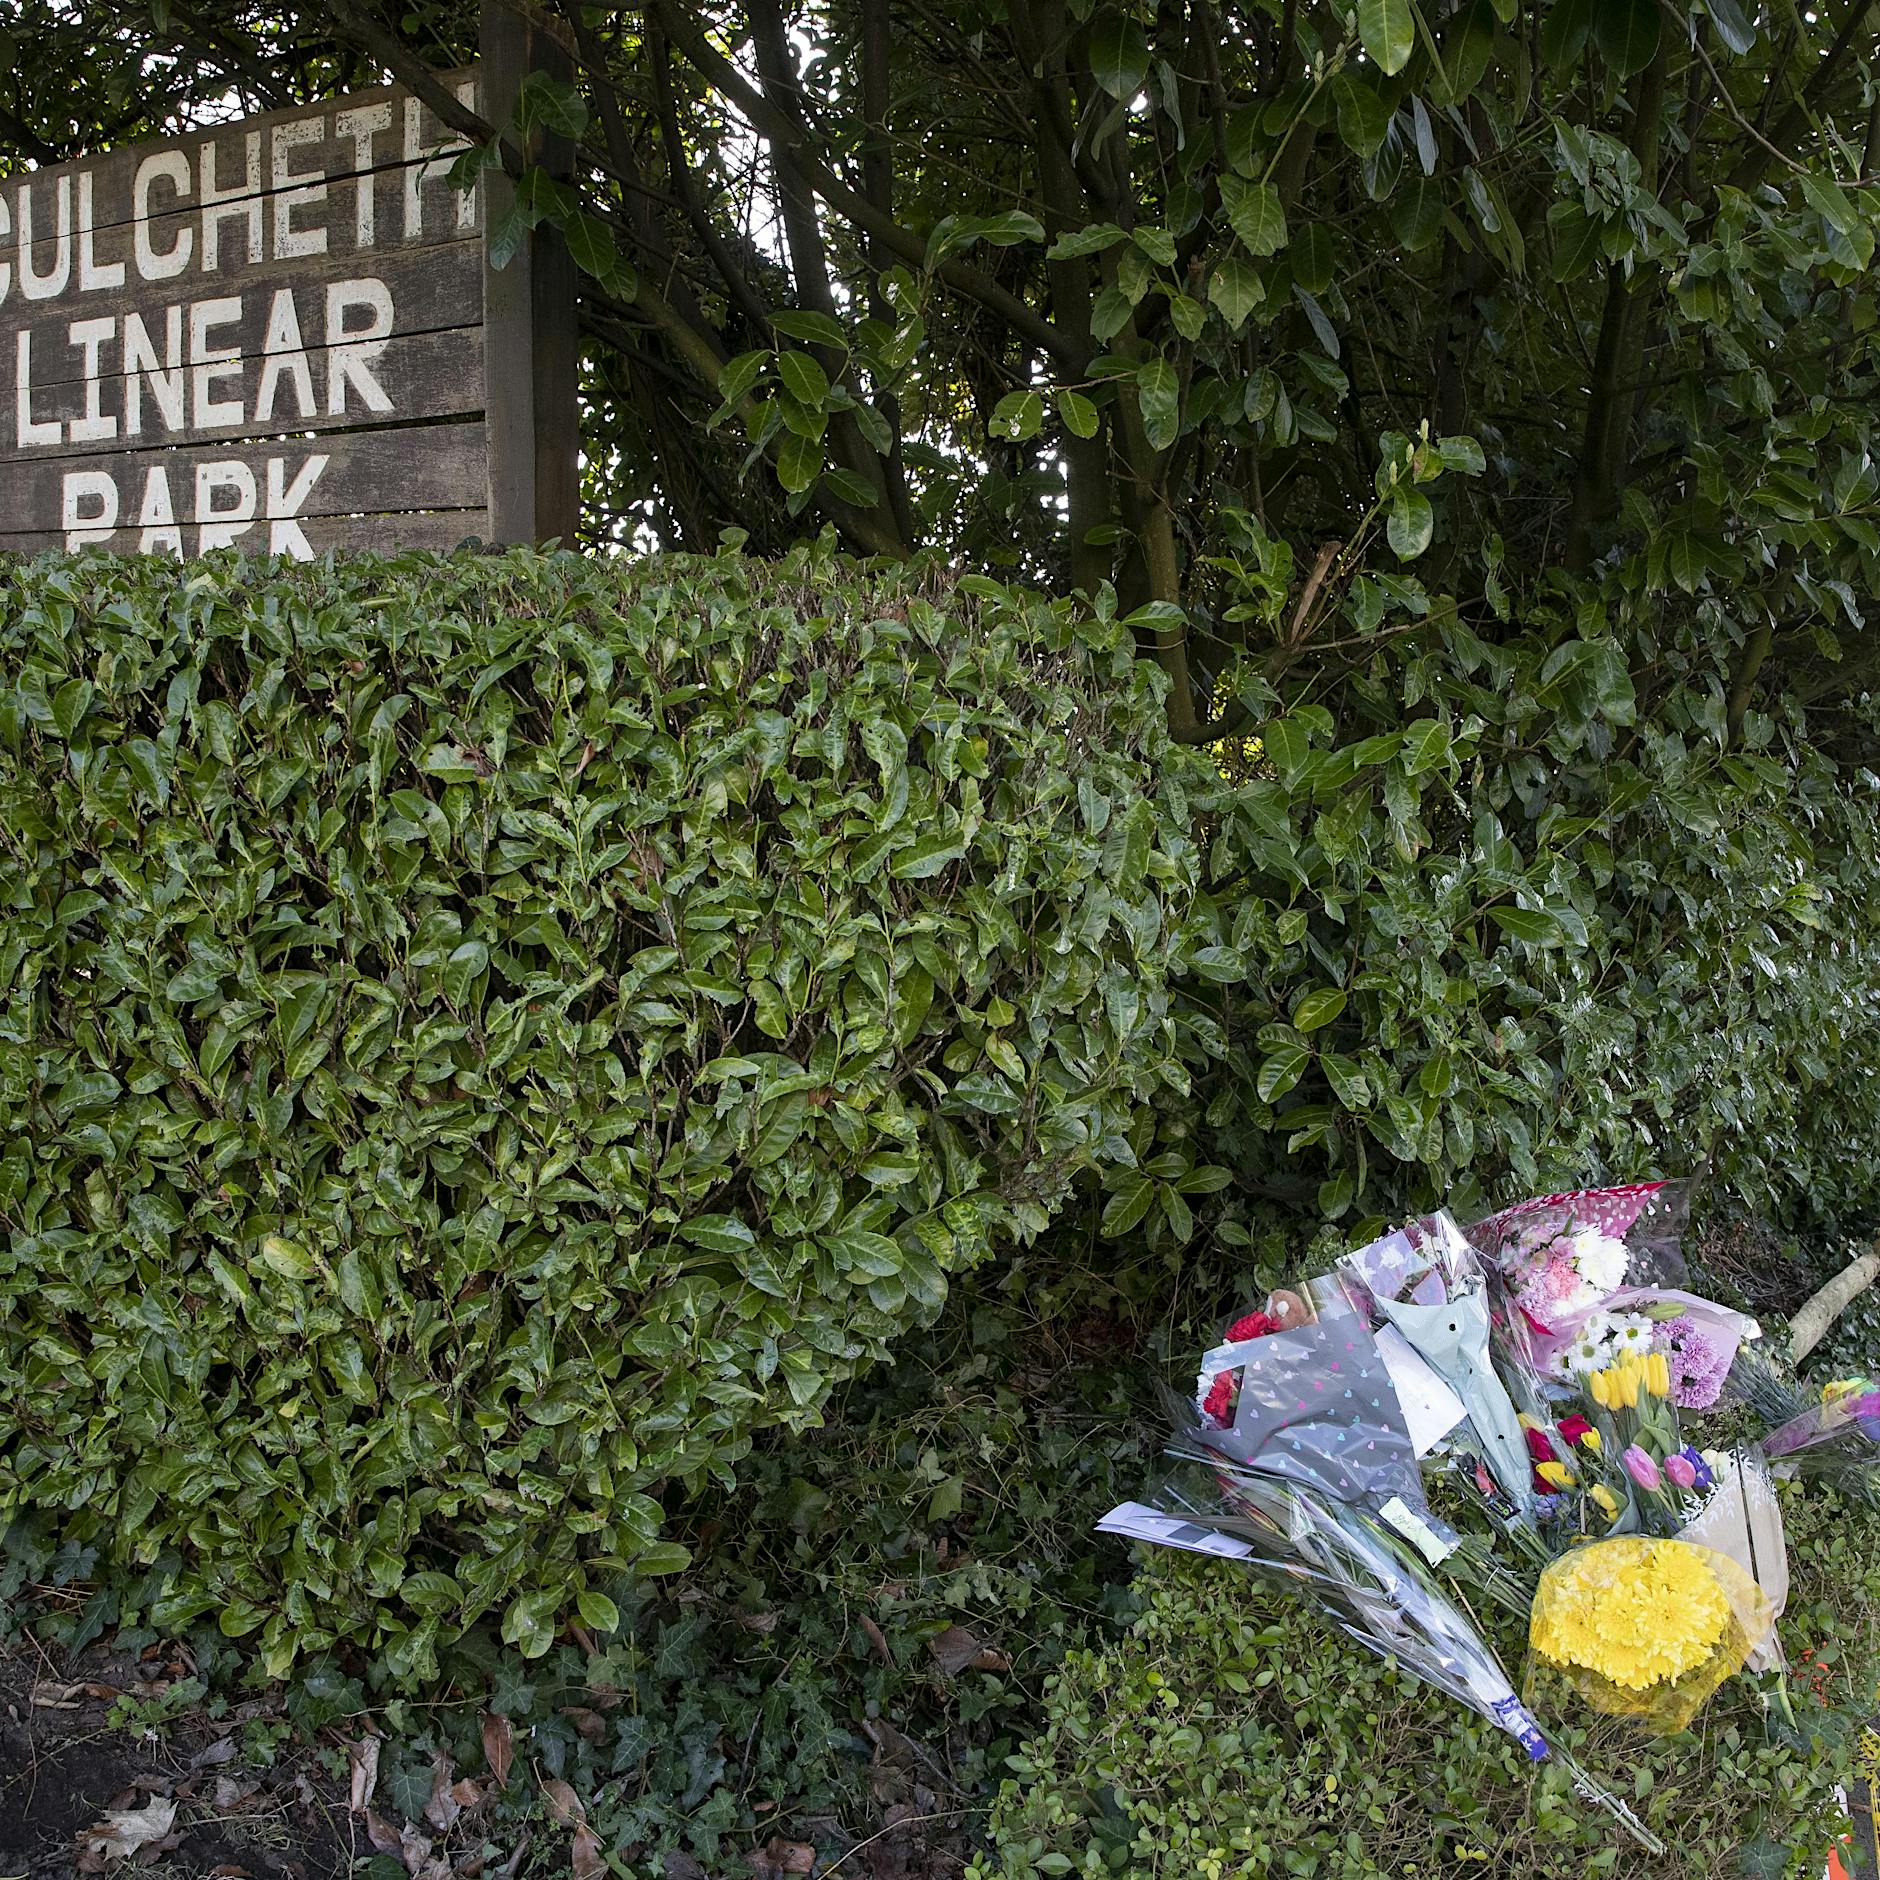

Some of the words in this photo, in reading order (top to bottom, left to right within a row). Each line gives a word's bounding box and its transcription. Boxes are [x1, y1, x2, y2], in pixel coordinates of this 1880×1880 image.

[0, 81, 476, 303] ULCHETH
[17, 277, 394, 448] LINEAR
[62, 455, 330, 565] PARK
